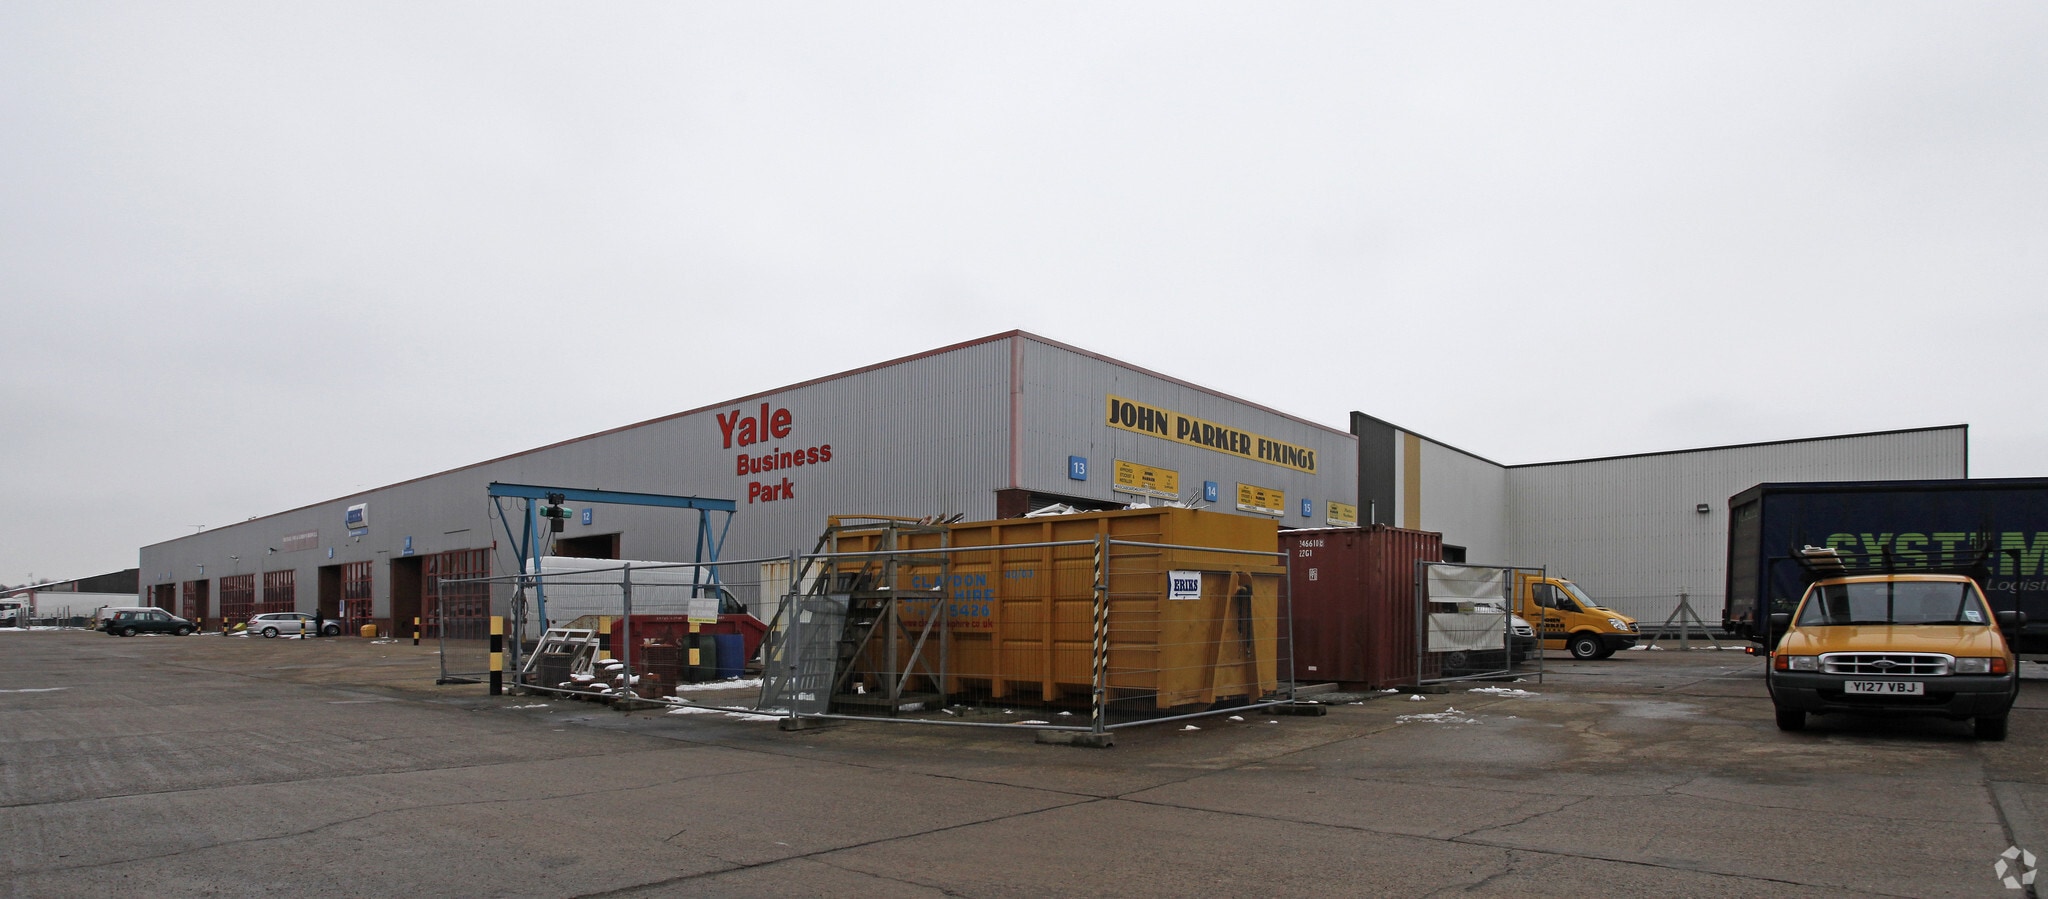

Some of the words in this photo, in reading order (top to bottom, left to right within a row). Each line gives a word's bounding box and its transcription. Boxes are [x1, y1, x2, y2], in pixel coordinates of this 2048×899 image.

[716, 402, 792, 449] Yale
[1109, 398, 1168, 436] JOHN
[1177, 416, 1251, 456] PARKER
[1258, 438, 1315, 471] FIXINGS
[737, 444, 832, 476] Business
[1073, 462, 1085, 475] 13
[748, 477, 794, 504] Park
[1207, 486, 1216, 496] 14
[1304, 503, 1311, 512] 15
[583, 512, 590, 521] 12
[912, 575, 986, 589] CLADON
[1174, 578, 1198, 591] ERIKS
[1986, 578, 2048, 595] Logist
[954, 589, 994, 602] HIRE
[1854, 682, 1883, 692] Y127
[1888, 682, 1915, 693] VBJ
